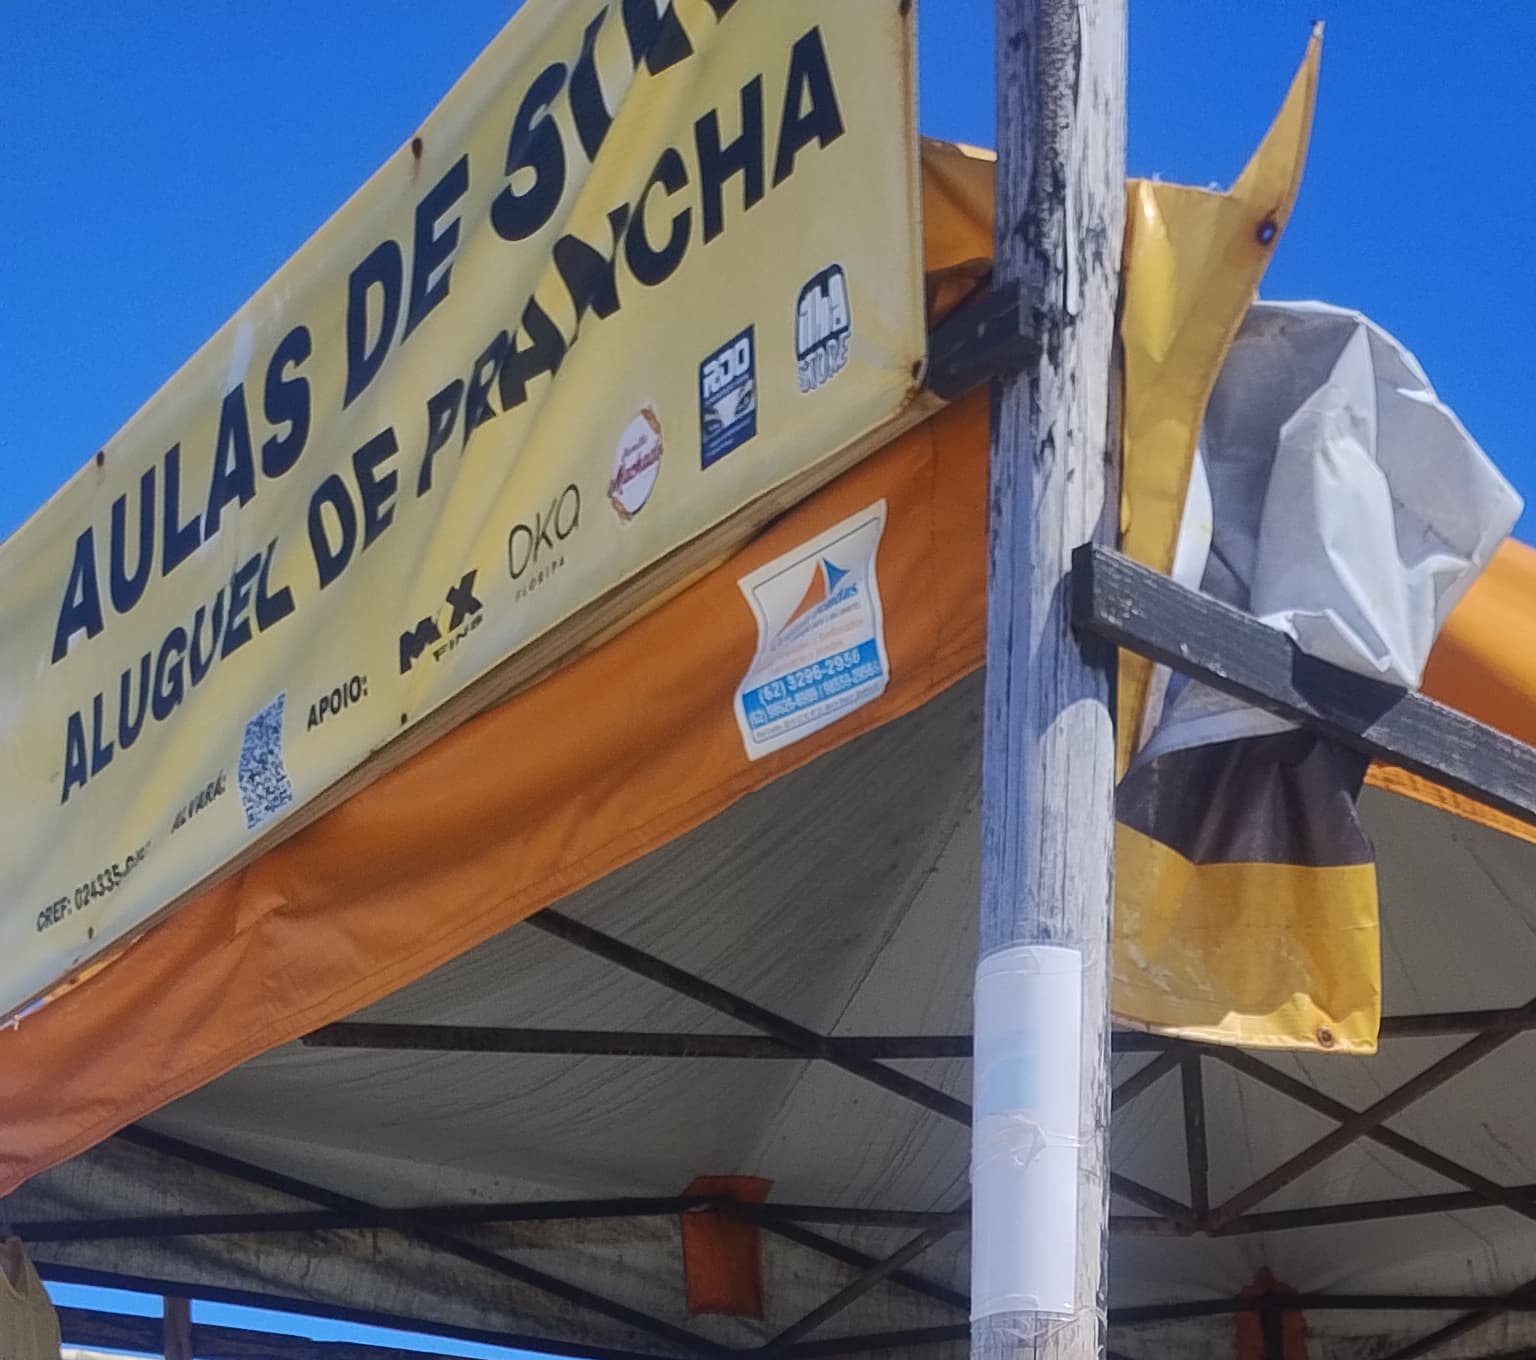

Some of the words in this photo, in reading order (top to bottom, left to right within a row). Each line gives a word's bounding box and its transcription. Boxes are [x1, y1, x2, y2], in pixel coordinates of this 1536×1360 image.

[51, 325, 312, 665] AULAS
[343, 153, 468, 411] DE
[489, 0, 738, 241] SU
[61, 537, 296, 805] ALUGUEL
[307, 426, 399, 591] DE
[416, 26, 846, 498] PRANCHA
[36, 895, 73, 933] CREF:
[305, 675, 368, 731] APOIO:
